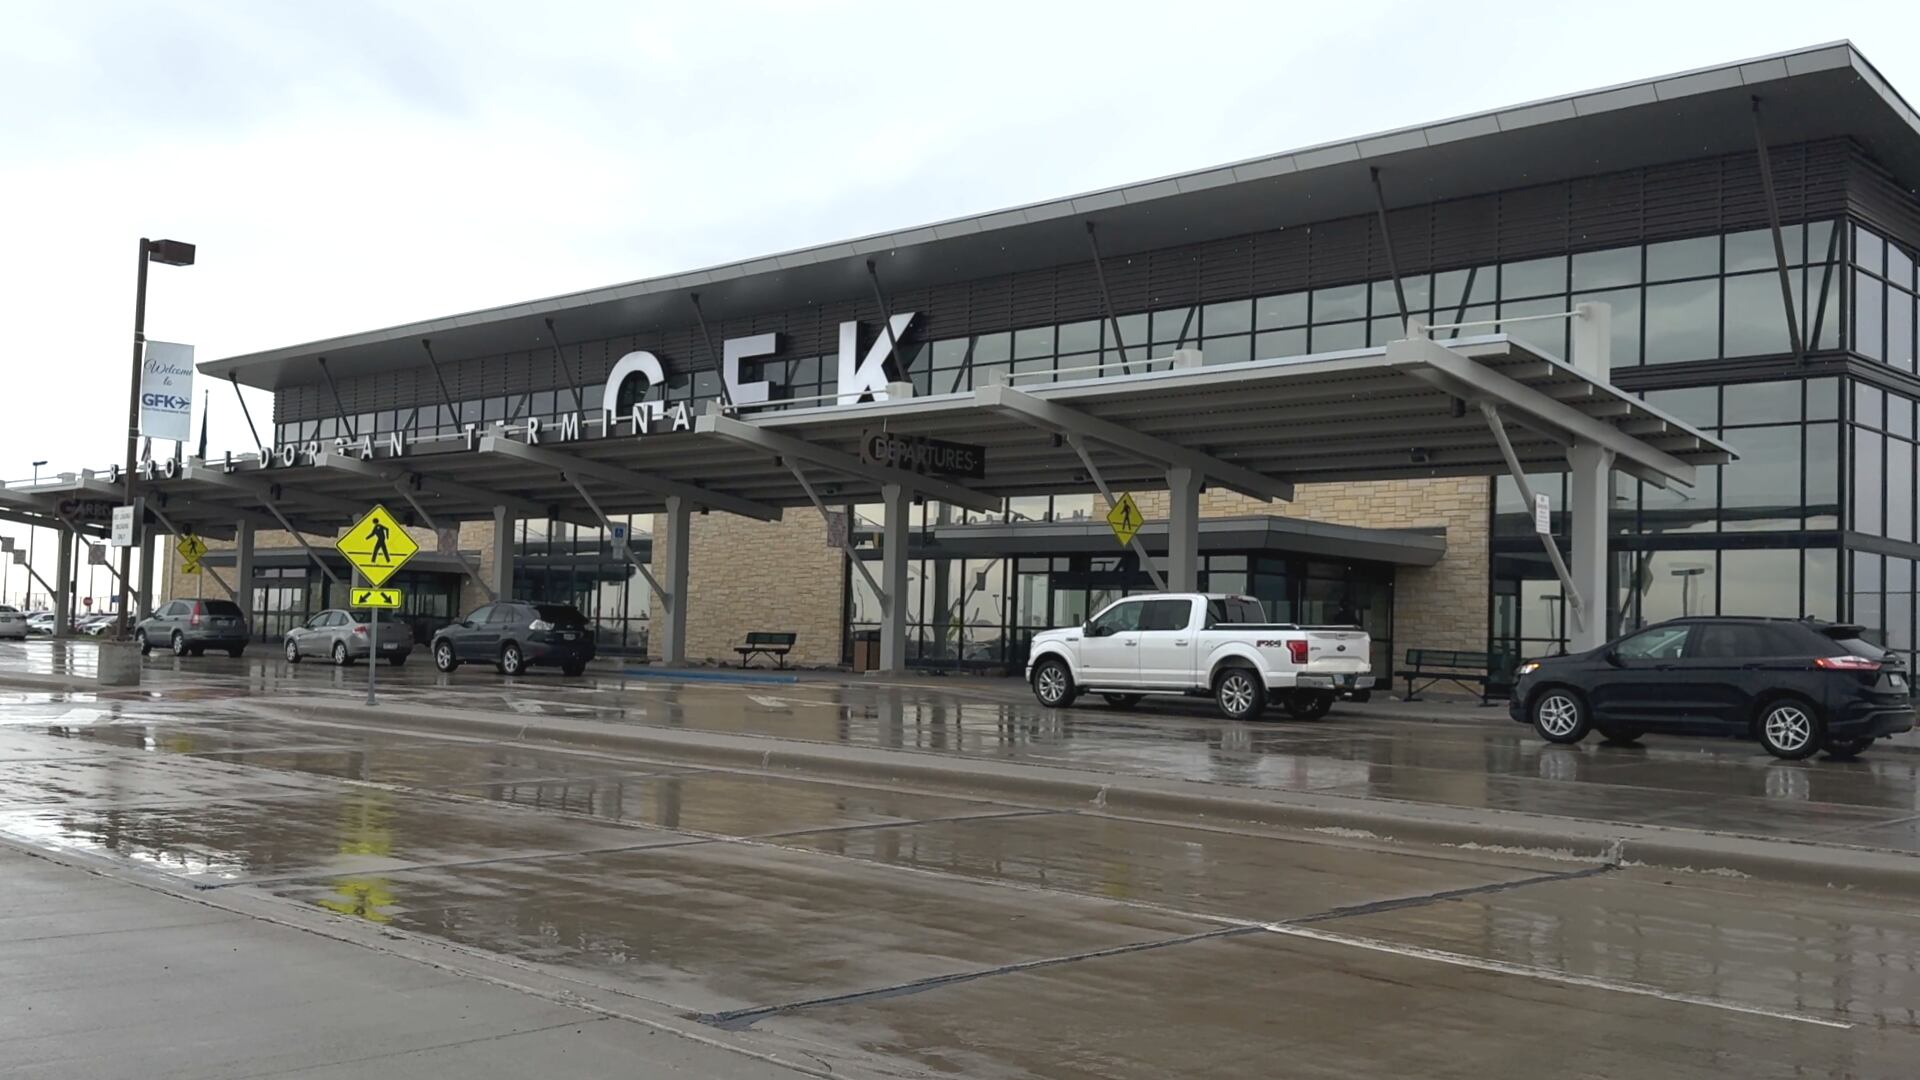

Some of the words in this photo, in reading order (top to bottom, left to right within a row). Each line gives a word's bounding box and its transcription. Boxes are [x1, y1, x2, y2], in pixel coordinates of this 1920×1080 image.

[602, 311, 916, 425] GFK
[142, 393, 176, 409] GFK
[259, 431, 404, 470] DORGAN
[874, 437, 975, 471] DEPARTURES
